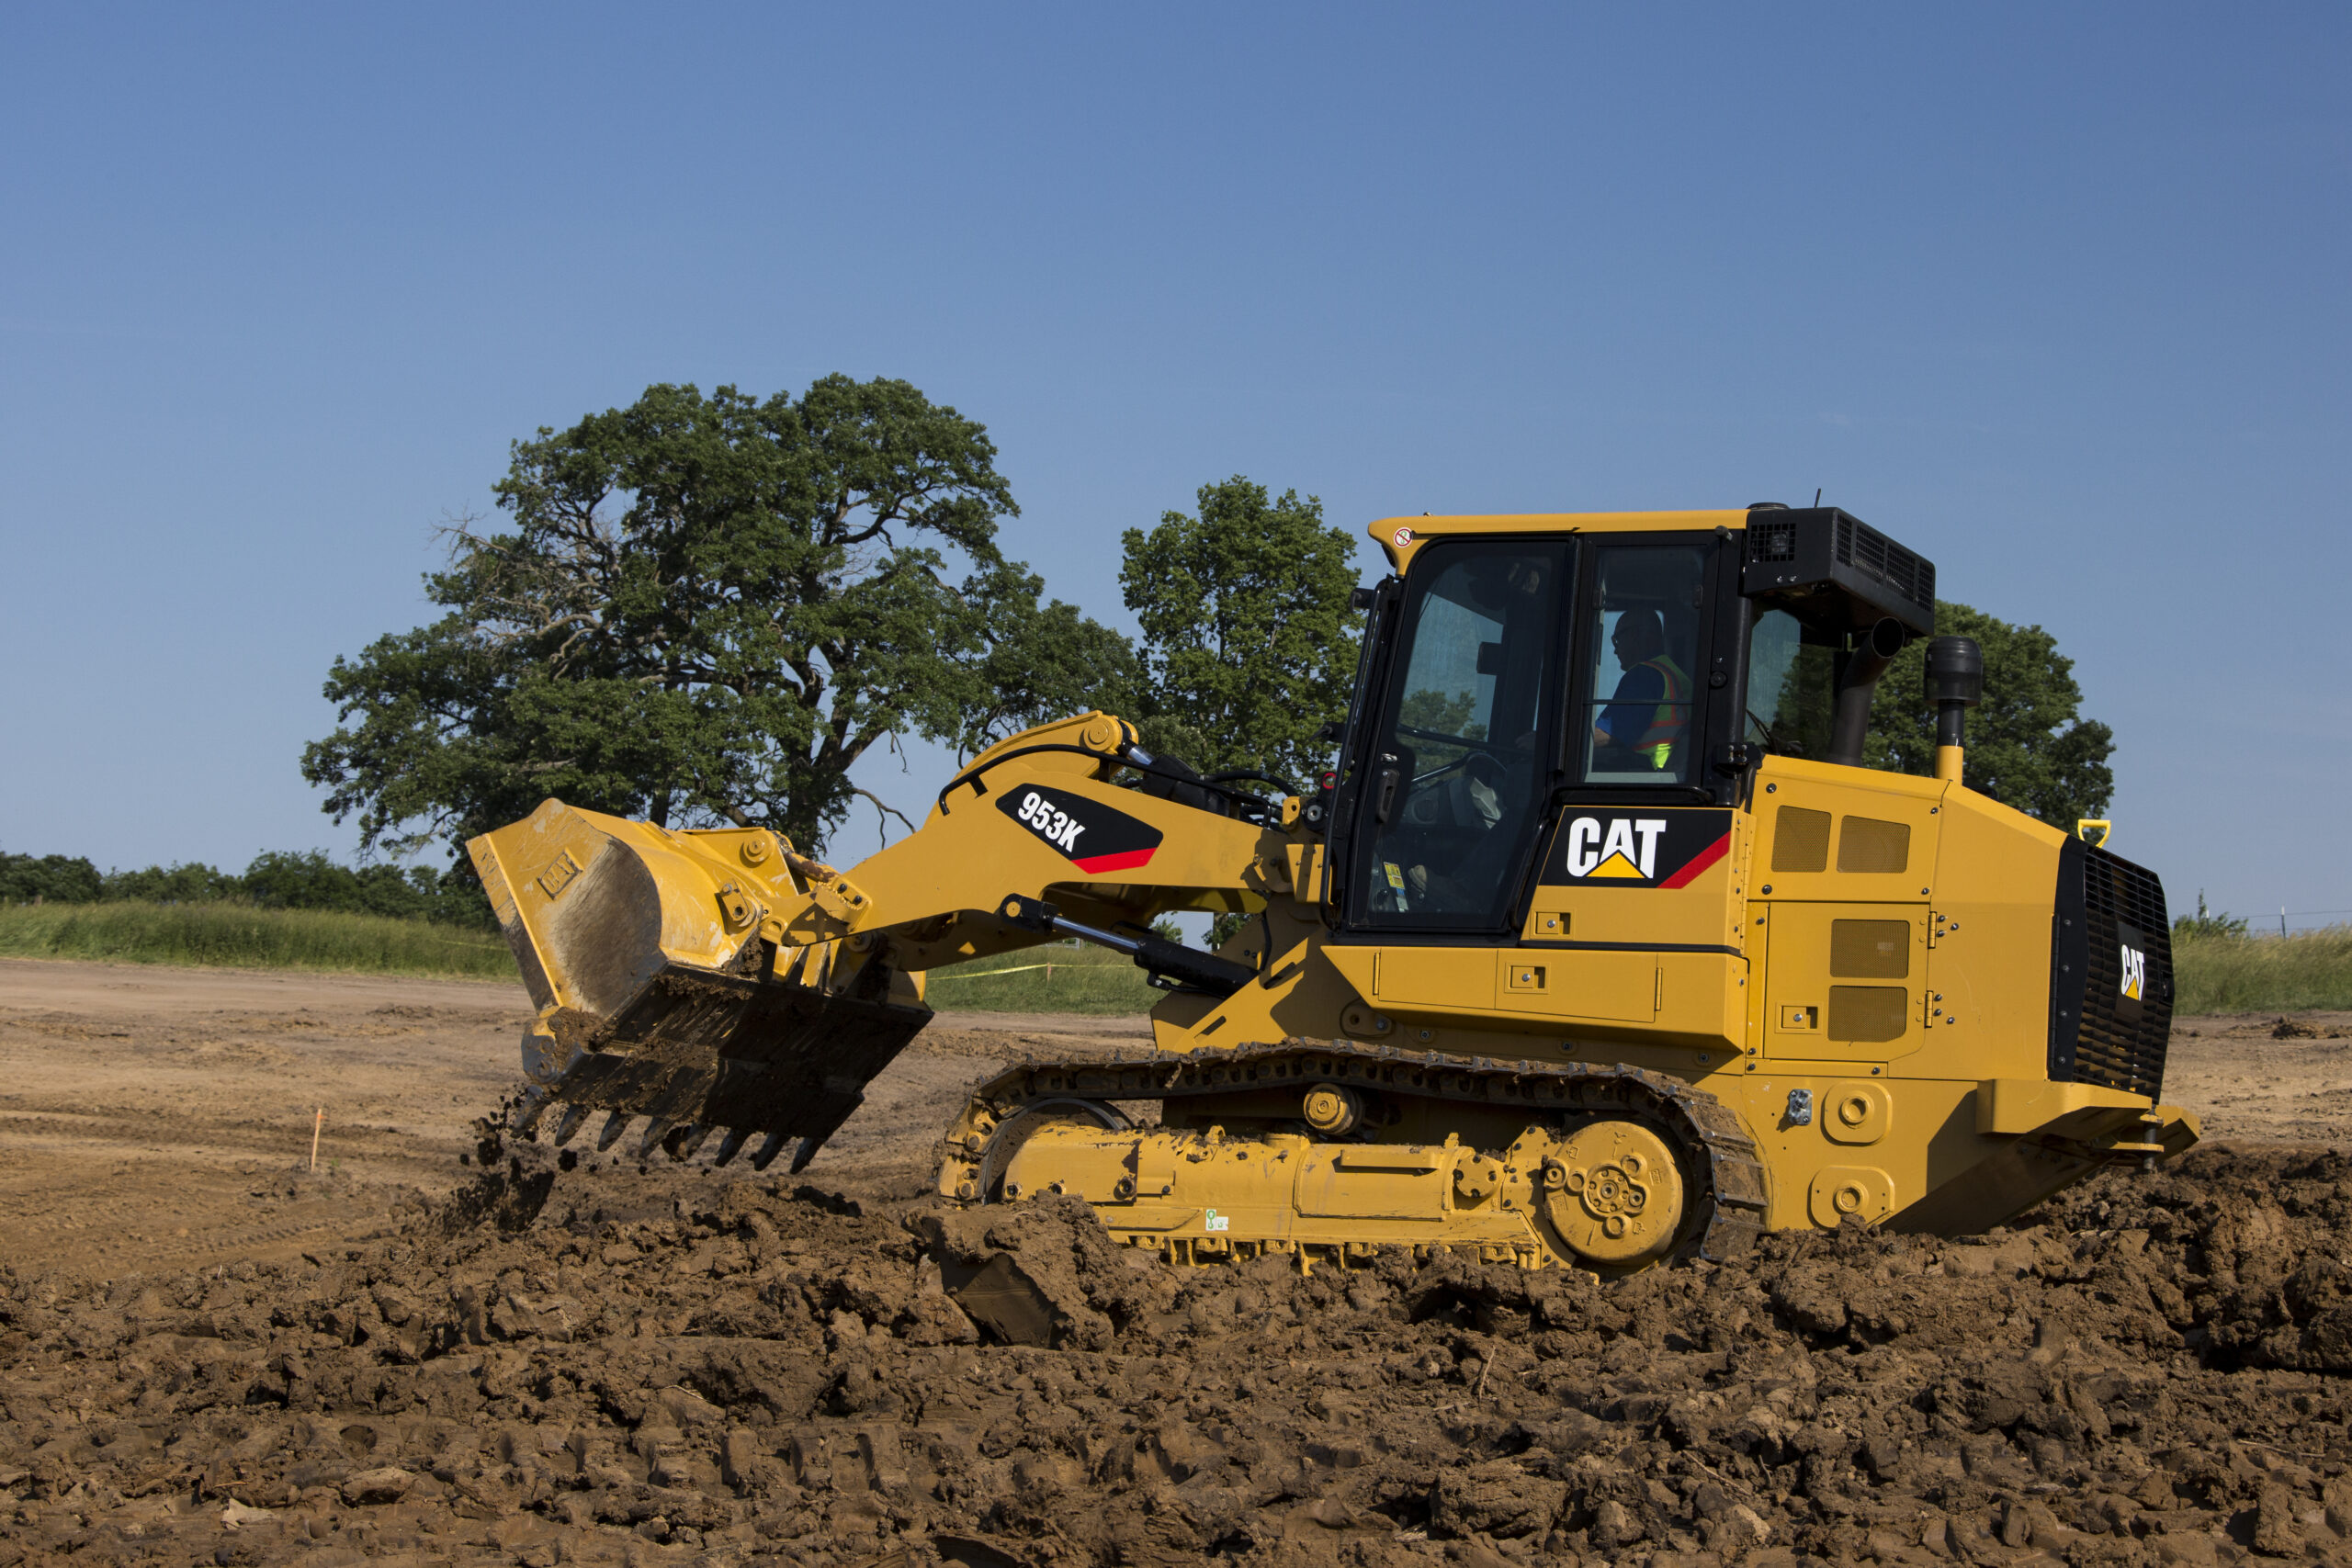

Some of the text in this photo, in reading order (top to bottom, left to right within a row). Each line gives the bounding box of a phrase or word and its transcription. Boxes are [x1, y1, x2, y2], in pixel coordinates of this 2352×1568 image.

[1017, 792, 1086, 853] 953K
[1566, 817, 1667, 879] CAT
[540, 853, 577, 895] CAT
[2120, 944, 2145, 1002] CAT
